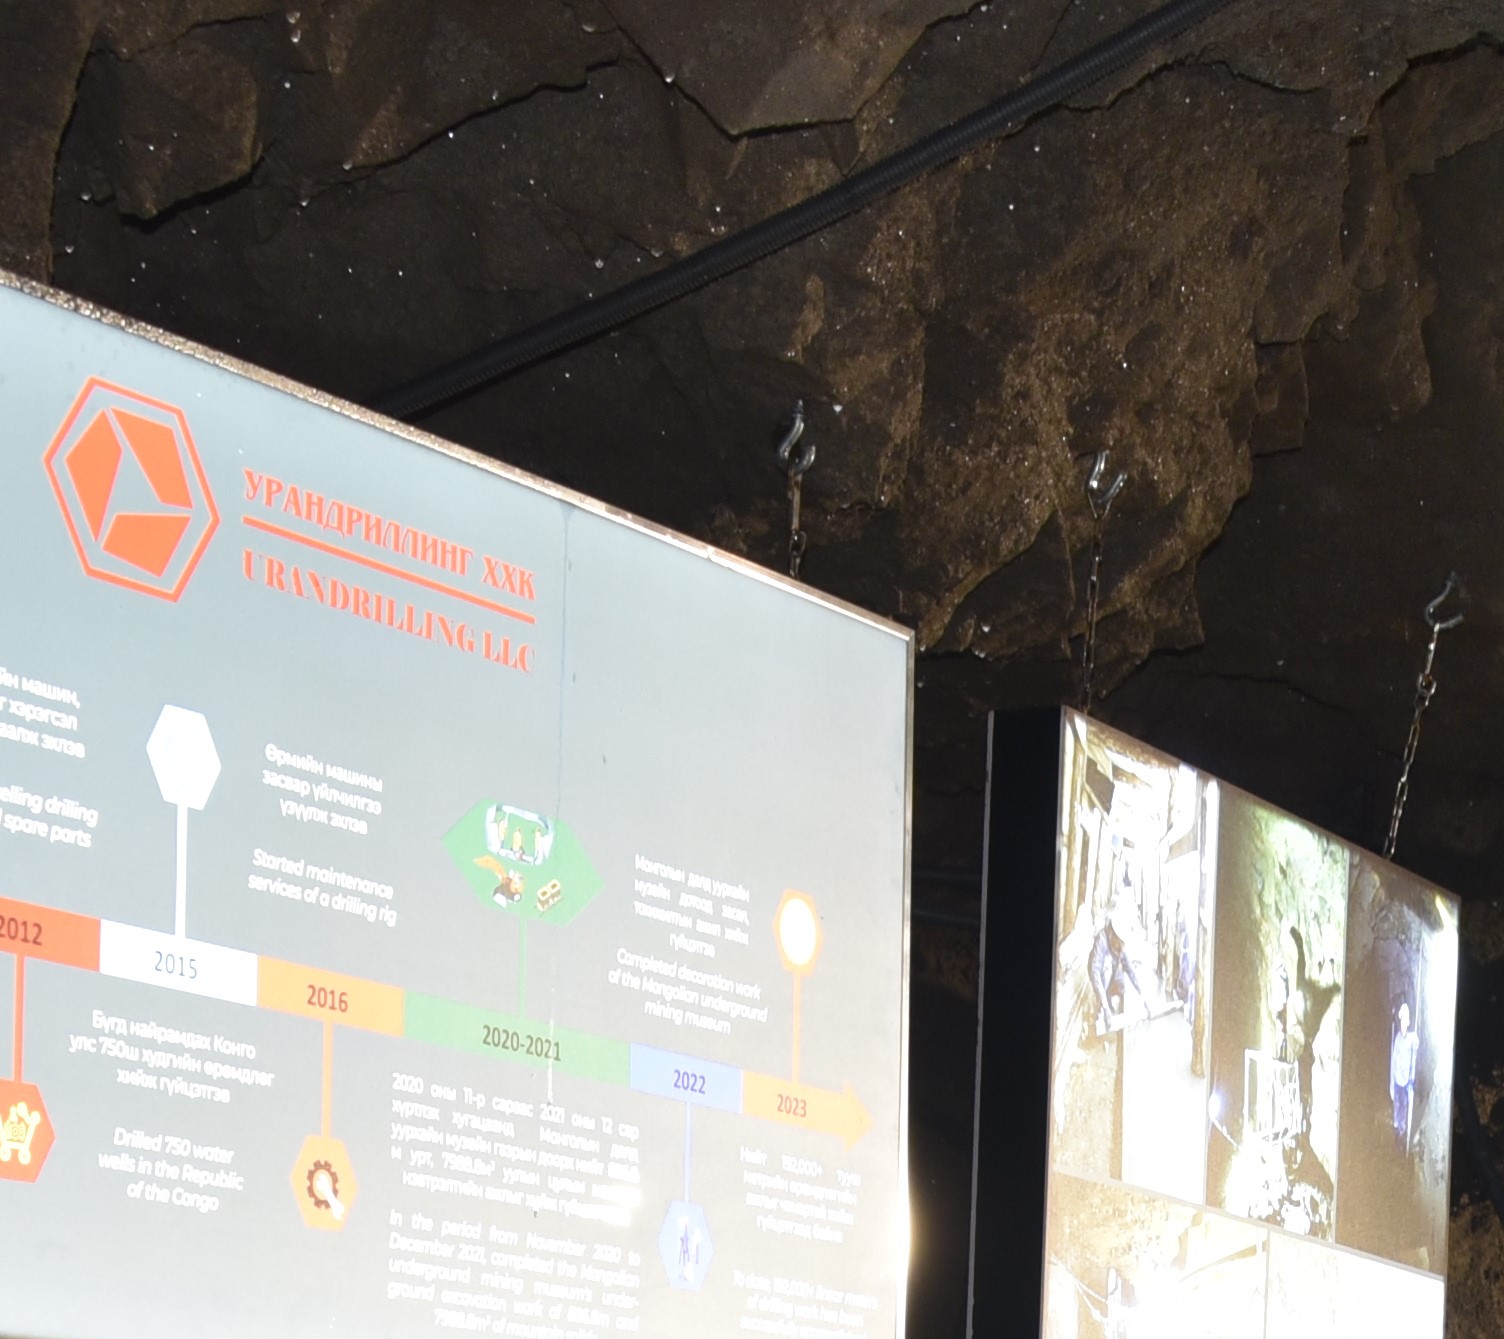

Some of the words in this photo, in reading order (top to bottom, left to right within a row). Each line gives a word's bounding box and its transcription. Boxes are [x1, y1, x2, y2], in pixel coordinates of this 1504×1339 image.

[243, 468, 473, 575] УРАНДРИЛЛИНГ
[483, 554, 536, 601] ХХК
[242, 549, 475, 653] URANDRILLING
[483, 629, 536, 673] LLC
[44, 796, 99, 828] drilling
[3, 813, 49, 837] spare
[50, 825, 91, 848] parts
[252, 848, 305, 877] Started
[306, 865, 394, 900] maintenance
[248, 874, 303, 900] services
[303, 886, 320, 904] of
[319, 892, 330, 907] a
[331, 893, 378, 923] drilling
[378, 904, 398, 928] rig
[153, 950, 198, 979] 2015
[307, 985, 348, 1012] 2016
[482, 1025, 562, 1062] 2020-2021
[673, 1069, 706, 1094] 2022
[776, 1094, 808, 1118] 2023
[113, 1127, 163, 1152] Drilled
[165, 1135, 192, 1157] 750
[192, 1144, 235, 1164] water
[98, 1152, 136, 1173] wells
[137, 1156, 153, 1175] in
[154, 1159, 180, 1180] the
[181, 1164, 244, 1191] Republic
[126, 1180, 145, 1199] of
[144, 1182, 171, 1203] the
[171, 1187, 220, 1214] Congo
